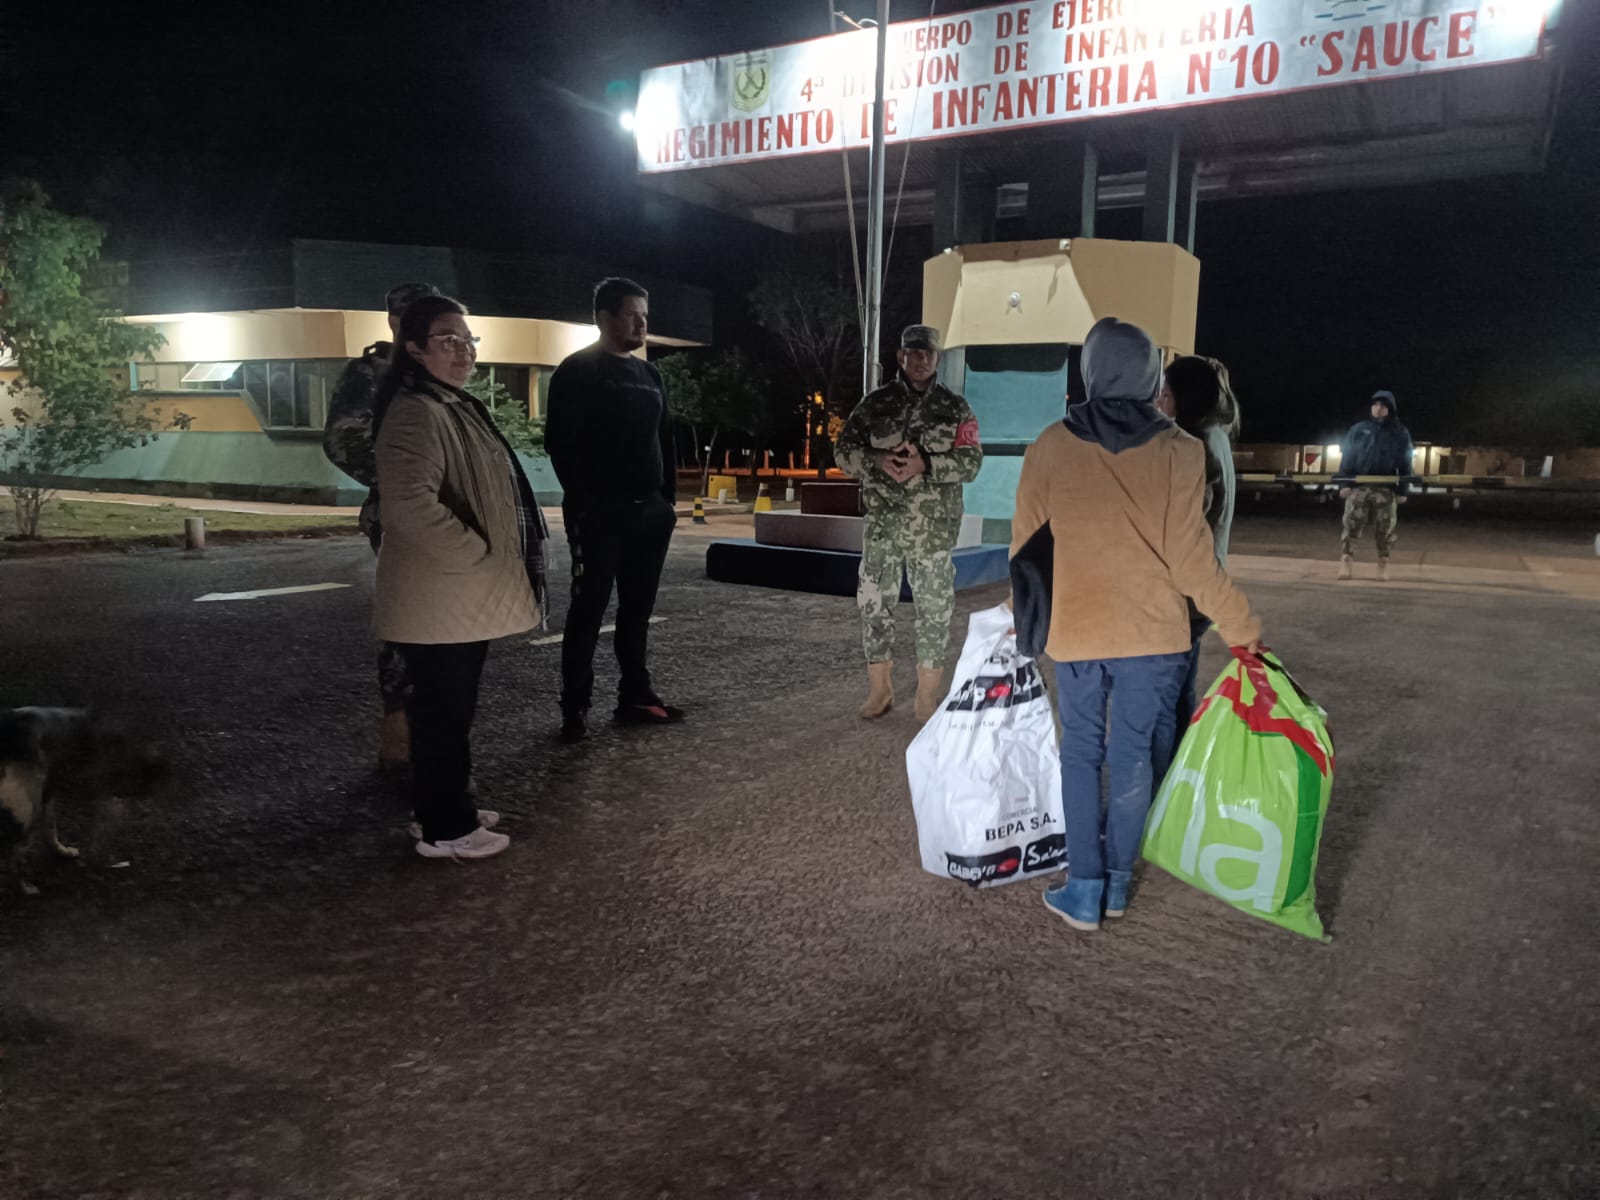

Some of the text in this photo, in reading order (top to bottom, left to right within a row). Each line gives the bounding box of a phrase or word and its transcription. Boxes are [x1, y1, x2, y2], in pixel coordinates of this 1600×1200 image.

[903, 19, 972, 54] UERPO
[996, 8, 1031, 39] DE
[993, 41, 1029, 75] DE
[656, 108, 834, 164] REGIMIENTO
[932, 60, 1158, 130] INFANTERIA
[985, 812, 1057, 842] BEPA S.A.
